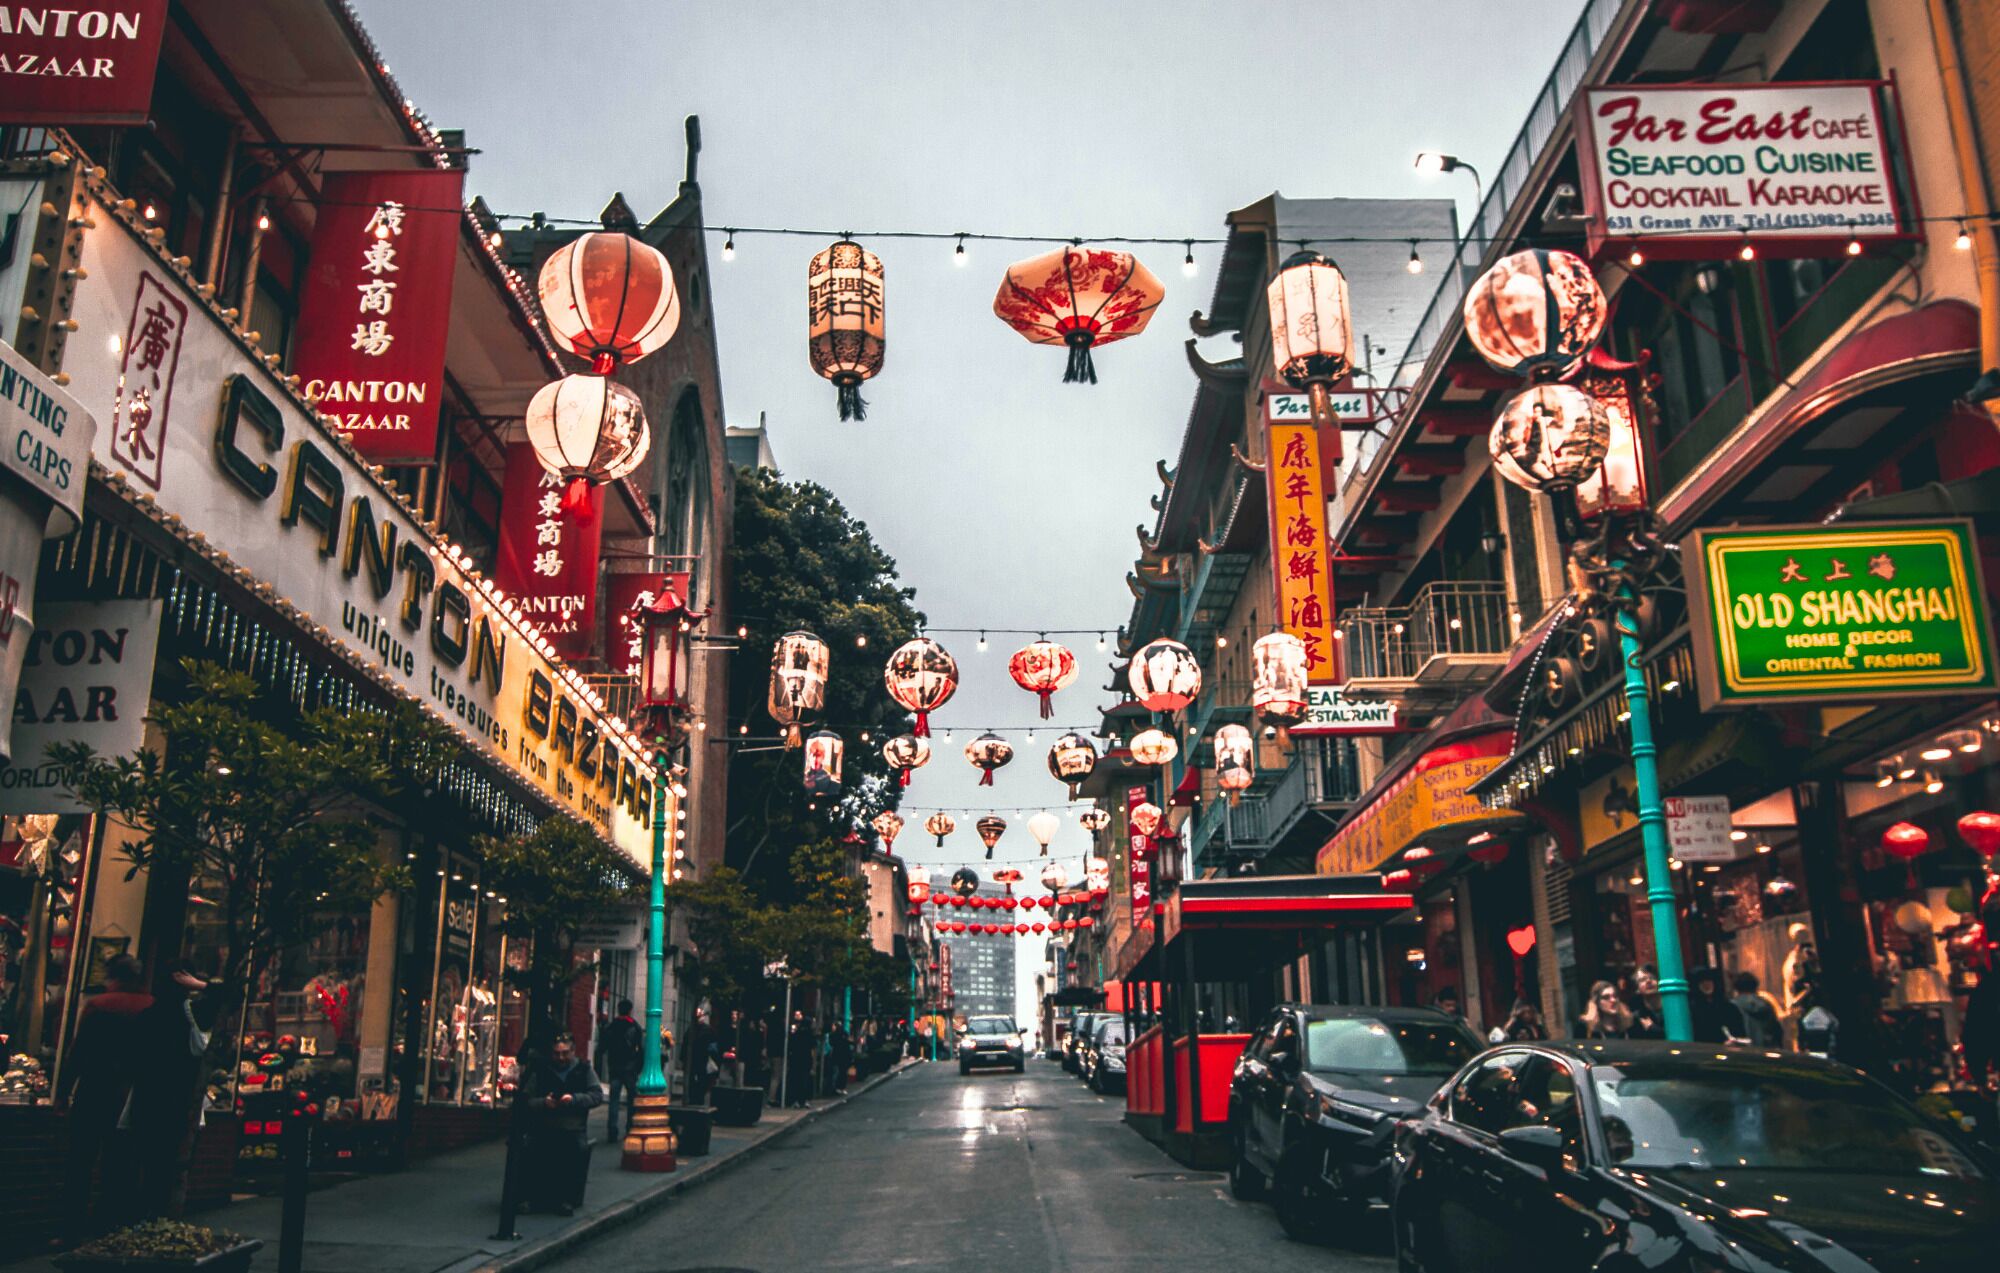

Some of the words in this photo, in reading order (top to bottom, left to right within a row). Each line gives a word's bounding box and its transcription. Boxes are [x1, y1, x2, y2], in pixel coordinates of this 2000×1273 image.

[1598, 96, 1686, 147] Far
[1696, 97, 1812, 145] East
[1811, 114, 1873, 140] CAFÉ
[1607, 147, 1745, 176] SEAFOOD
[1755, 145, 1875, 175] CUISINE
[1607, 179, 1742, 209] COCKTAIL
[1748, 178, 1884, 206] KARAOKE
[1607, 215, 1632, 230] 631
[1640, 214, 1691, 230] Grant
[0, 361, 68, 438] NTING
[303, 379, 427, 404] CANTON
[1275, 396, 1310, 415] Far
[1330, 397, 1361, 413] ast
[325, 413, 411, 431] AZAAR
[16, 429, 73, 490] CAPS
[1279, 432, 1327, 672] 康年海鮮酒家
[217, 373, 506, 699] CANTON
[524, 668, 653, 830] BAZAAR
[1733, 592, 1794, 630] OLD
[1800, 586, 1957, 627] SHANGHAI
[536, 620, 578, 633] ZAAR
[1785, 632, 1840, 648] HOME
[1847, 629, 1913, 646] DECOR
[1766, 656, 1855, 673] ORIENTAL
[1863, 652, 1942, 669] FASHION
[342, 600, 414, 677] unique
[430, 665, 508, 751] treasures
[519, 737, 548, 781] from
[556, 768, 574, 801] the
[581, 792, 611, 827] orient
[1464, 762, 1488, 777] Bar
[448, 898, 473, 935] sale
